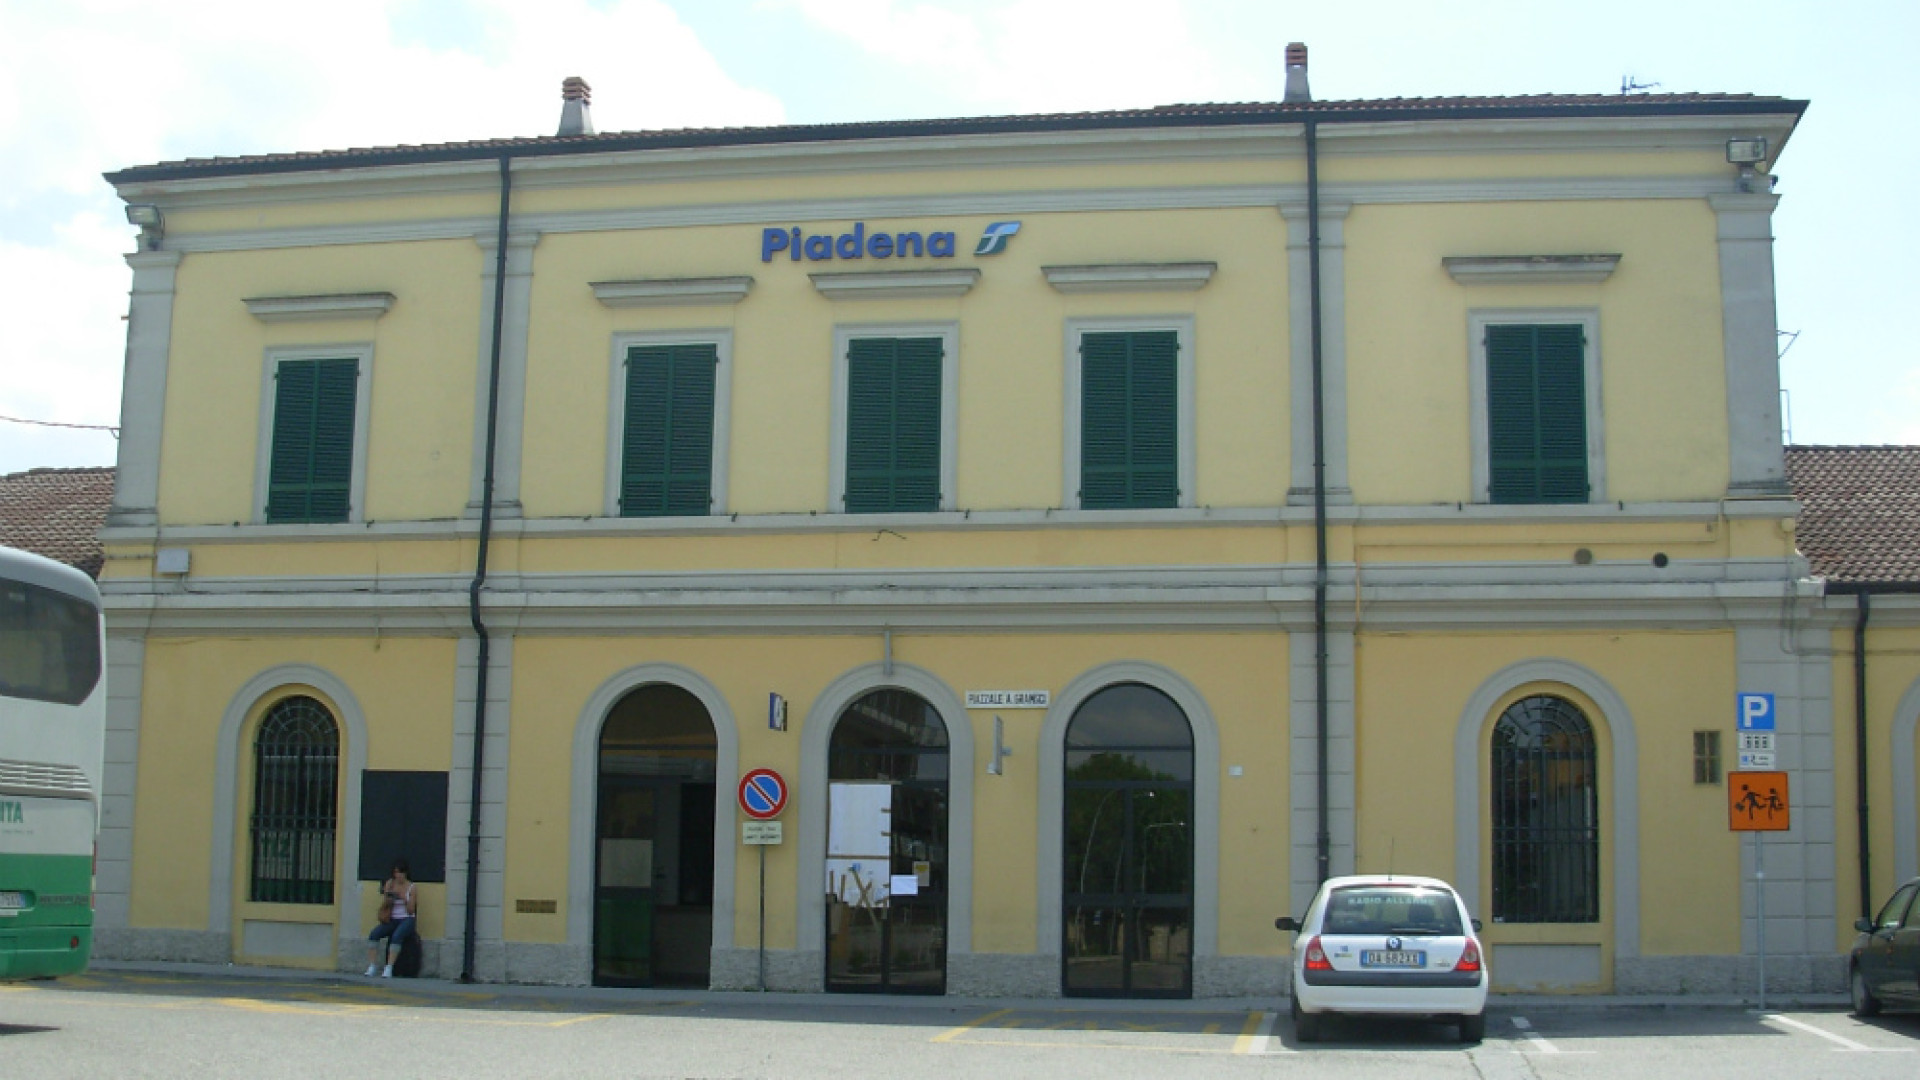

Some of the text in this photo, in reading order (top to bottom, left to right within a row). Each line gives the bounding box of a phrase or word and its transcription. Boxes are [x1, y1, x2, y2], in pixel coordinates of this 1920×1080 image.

[762, 222, 954, 262] Piadena
[968, 693, 1003, 705] PIAZZALE
[1743, 695, 1768, 728] P
